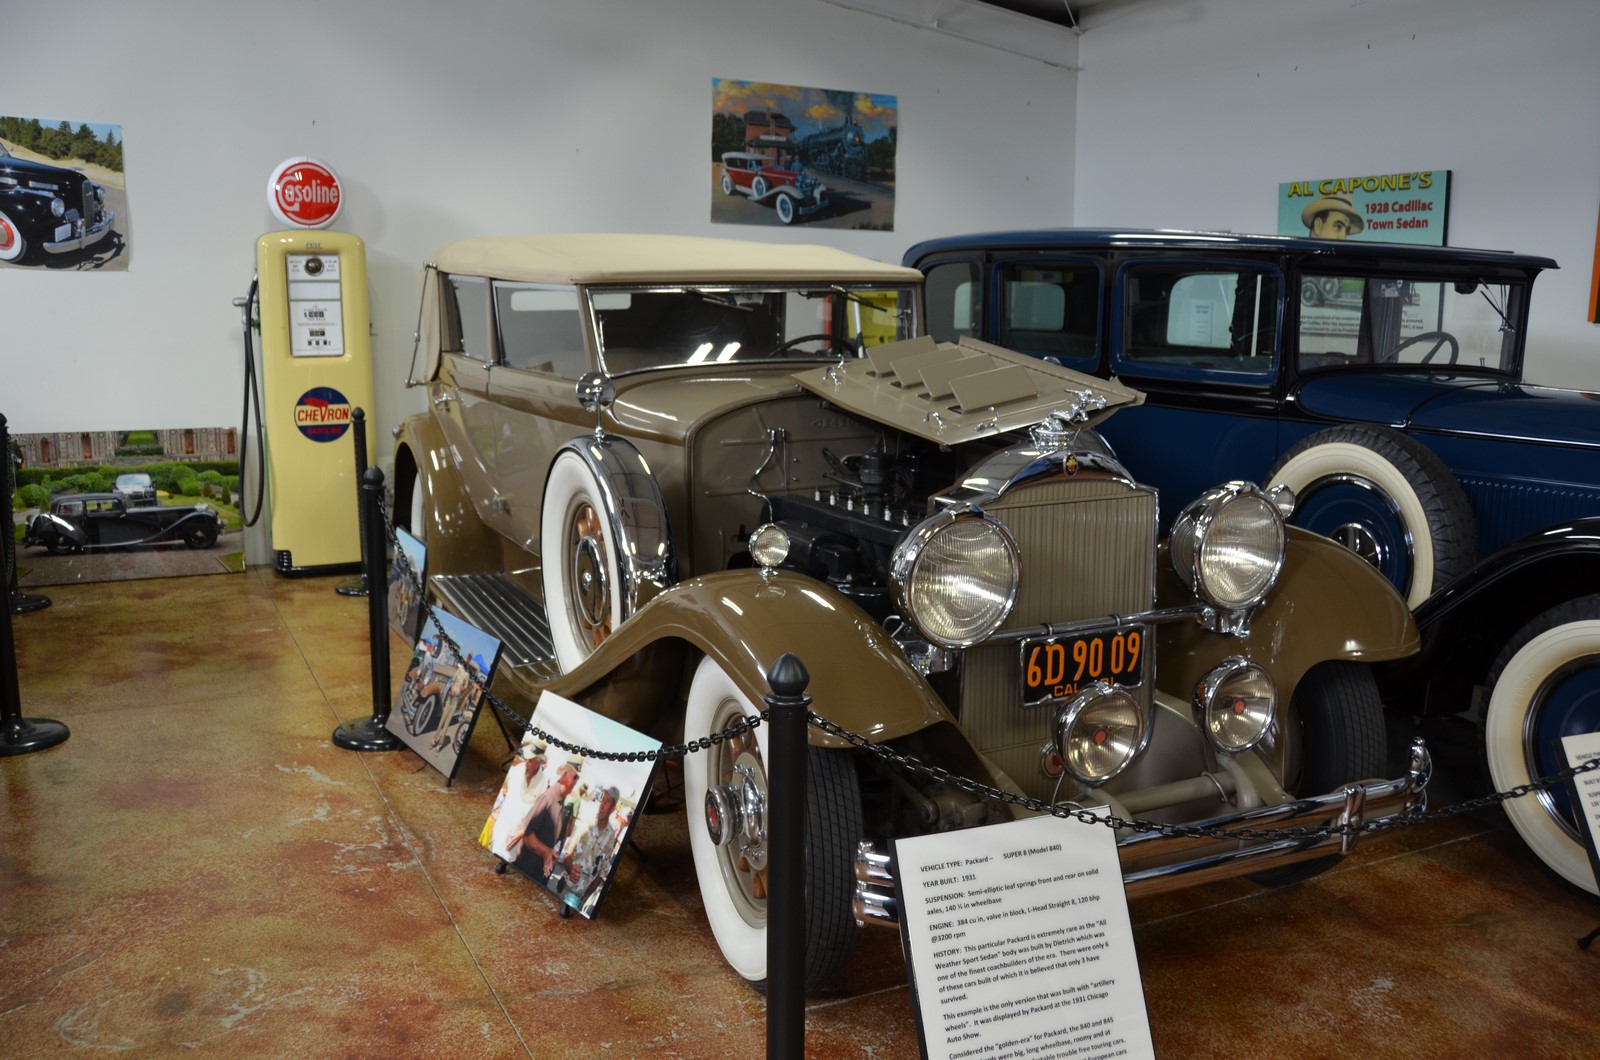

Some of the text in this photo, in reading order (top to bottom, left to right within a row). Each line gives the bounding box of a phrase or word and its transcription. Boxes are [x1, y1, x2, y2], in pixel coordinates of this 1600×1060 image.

[277, 175, 339, 211] Gasoline
[1288, 171, 1433, 197] AL CAPONE'S
[1365, 200, 1433, 214] 1928 Cadillac
[1366, 217, 1428, 230] Town Sedan
[297, 406, 349, 422] CHEVRON
[1027, 632, 1141, 688] 6D 90 09
[920, 863, 945, 872] VEHICLE
[965, 856, 989, 865] Packard
[1003, 851, 1023, 860] SUPER
[1028, 846, 1049, 856] (Model
[1049, 844, 1062, 852] 840)
[922, 874, 976, 888] YEAR BUILT: 1931
[925, 892, 965, 904] SUSPENSION:
[968, 886, 1004, 897] Semi-elliptic
[1017, 881, 1037, 889] springs
[1053, 874, 1064, 882] and
[1086, 868, 1099, 876] solid
[927, 908, 944, 916] axles,
[971, 898, 1002, 908] wheelbase
[929, 921, 954, 931] ENGINE:
[957, 919, 968, 927] 384
[1009, 909, 1027, 917] block,
[1028, 904, 1048, 913] L-Head
[1048, 901, 1071, 910] Straight
[931, 932, 966, 944] @3200 rpm
[933, 948, 962, 958] HISTORY:
[964, 945, 977, 953] This
[978, 940, 1006, 951] particular
[1007, 934, 1030, 944] Packard
[1037, 928, 1065, 939] extremely
[935, 961, 962, 970] Weather
[962, 957, 979, 965] Sport
[1002, 949, 1017, 957] body
[1053, 937, 1076, 947] Dietrich
[1076, 934, 1093, 942] which
[946, 984, 964, 992] these
[977, 977, 992, 985] built
[1000, 972, 1018, 980] which
[1030, 964, 1055, 974] believed
[969, 967, 986, 975] finest
[987, 960, 1027, 972] coachbuilders
[1028, 956, 1034, 964] of
[941, 994, 968, 1005] survived.
[943, 1013, 956, 1021] This
[957, 1008, 982, 1018] example
[1001, 1001, 1014, 1009] only
[1014, 997, 1036, 1005] version
[1037, 993, 1050, 1001] that
[1062, 987, 1076, 995] built
[1077, 984, 1090, 992] with
[993, 1010, 1021, 1022] displayed
[1030, 1003, 1054, 1014] Packard
[1073, 996, 1086, 1004] 1931
[1087, 992, 1109, 1001] Chicago
[947, 1032, 982, 1044] Auto Show.
[949, 1047, 984, 1060] Considered
[1044, 1028, 1069, 1038] Packard,
[1080, 1022, 1091, 1030] 840
[1092, 1019, 1103, 1028] and
[1103, 1017, 1114, 1025] 845
[1040, 1040, 1073, 1051] wheelbase,
[1074, 1035, 1092, 1043] roomy
[1093, 1031, 1104, 1039] and
[1056, 1049, 1078, 1059] trouble
[1091, 1042, 1112, 1050] touring
